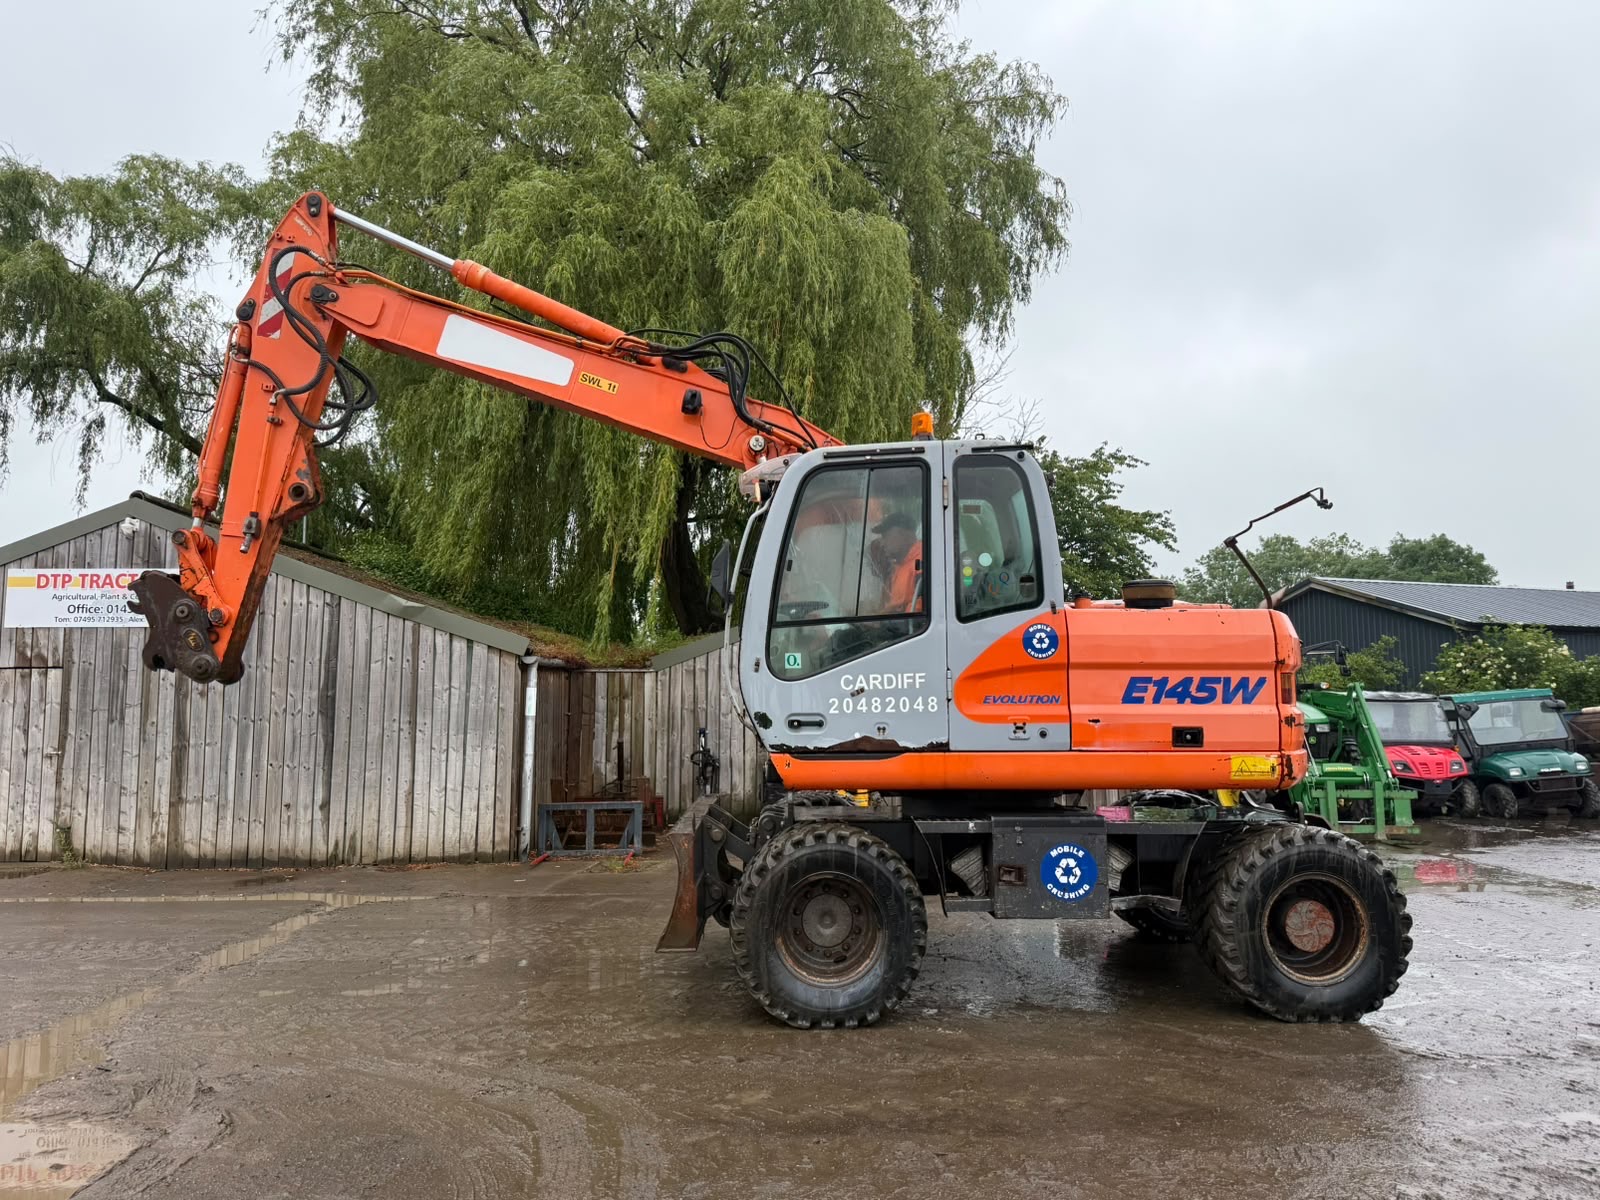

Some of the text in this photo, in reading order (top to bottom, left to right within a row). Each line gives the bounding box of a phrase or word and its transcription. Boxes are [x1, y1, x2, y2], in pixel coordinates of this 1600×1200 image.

[580, 373, 616, 393] SWL 1t
[37, 573, 73, 589] DTP
[101, 593, 119, 601] Plant
[122, 593, 128, 601] &
[67, 604, 104, 614] Office:
[1028, 624, 1052, 633] MOBILE
[1027, 647, 1056, 658] CRUSHING
[840, 672, 927, 691] CARDIFF
[1121, 676, 1267, 705] E145W
[828, 696, 938, 714] 20482048
[983, 695, 1062, 704] EVOLUTION
[1049, 845, 1085, 858] MOBILE
[1046, 883, 1090, 899] CRUSHING
